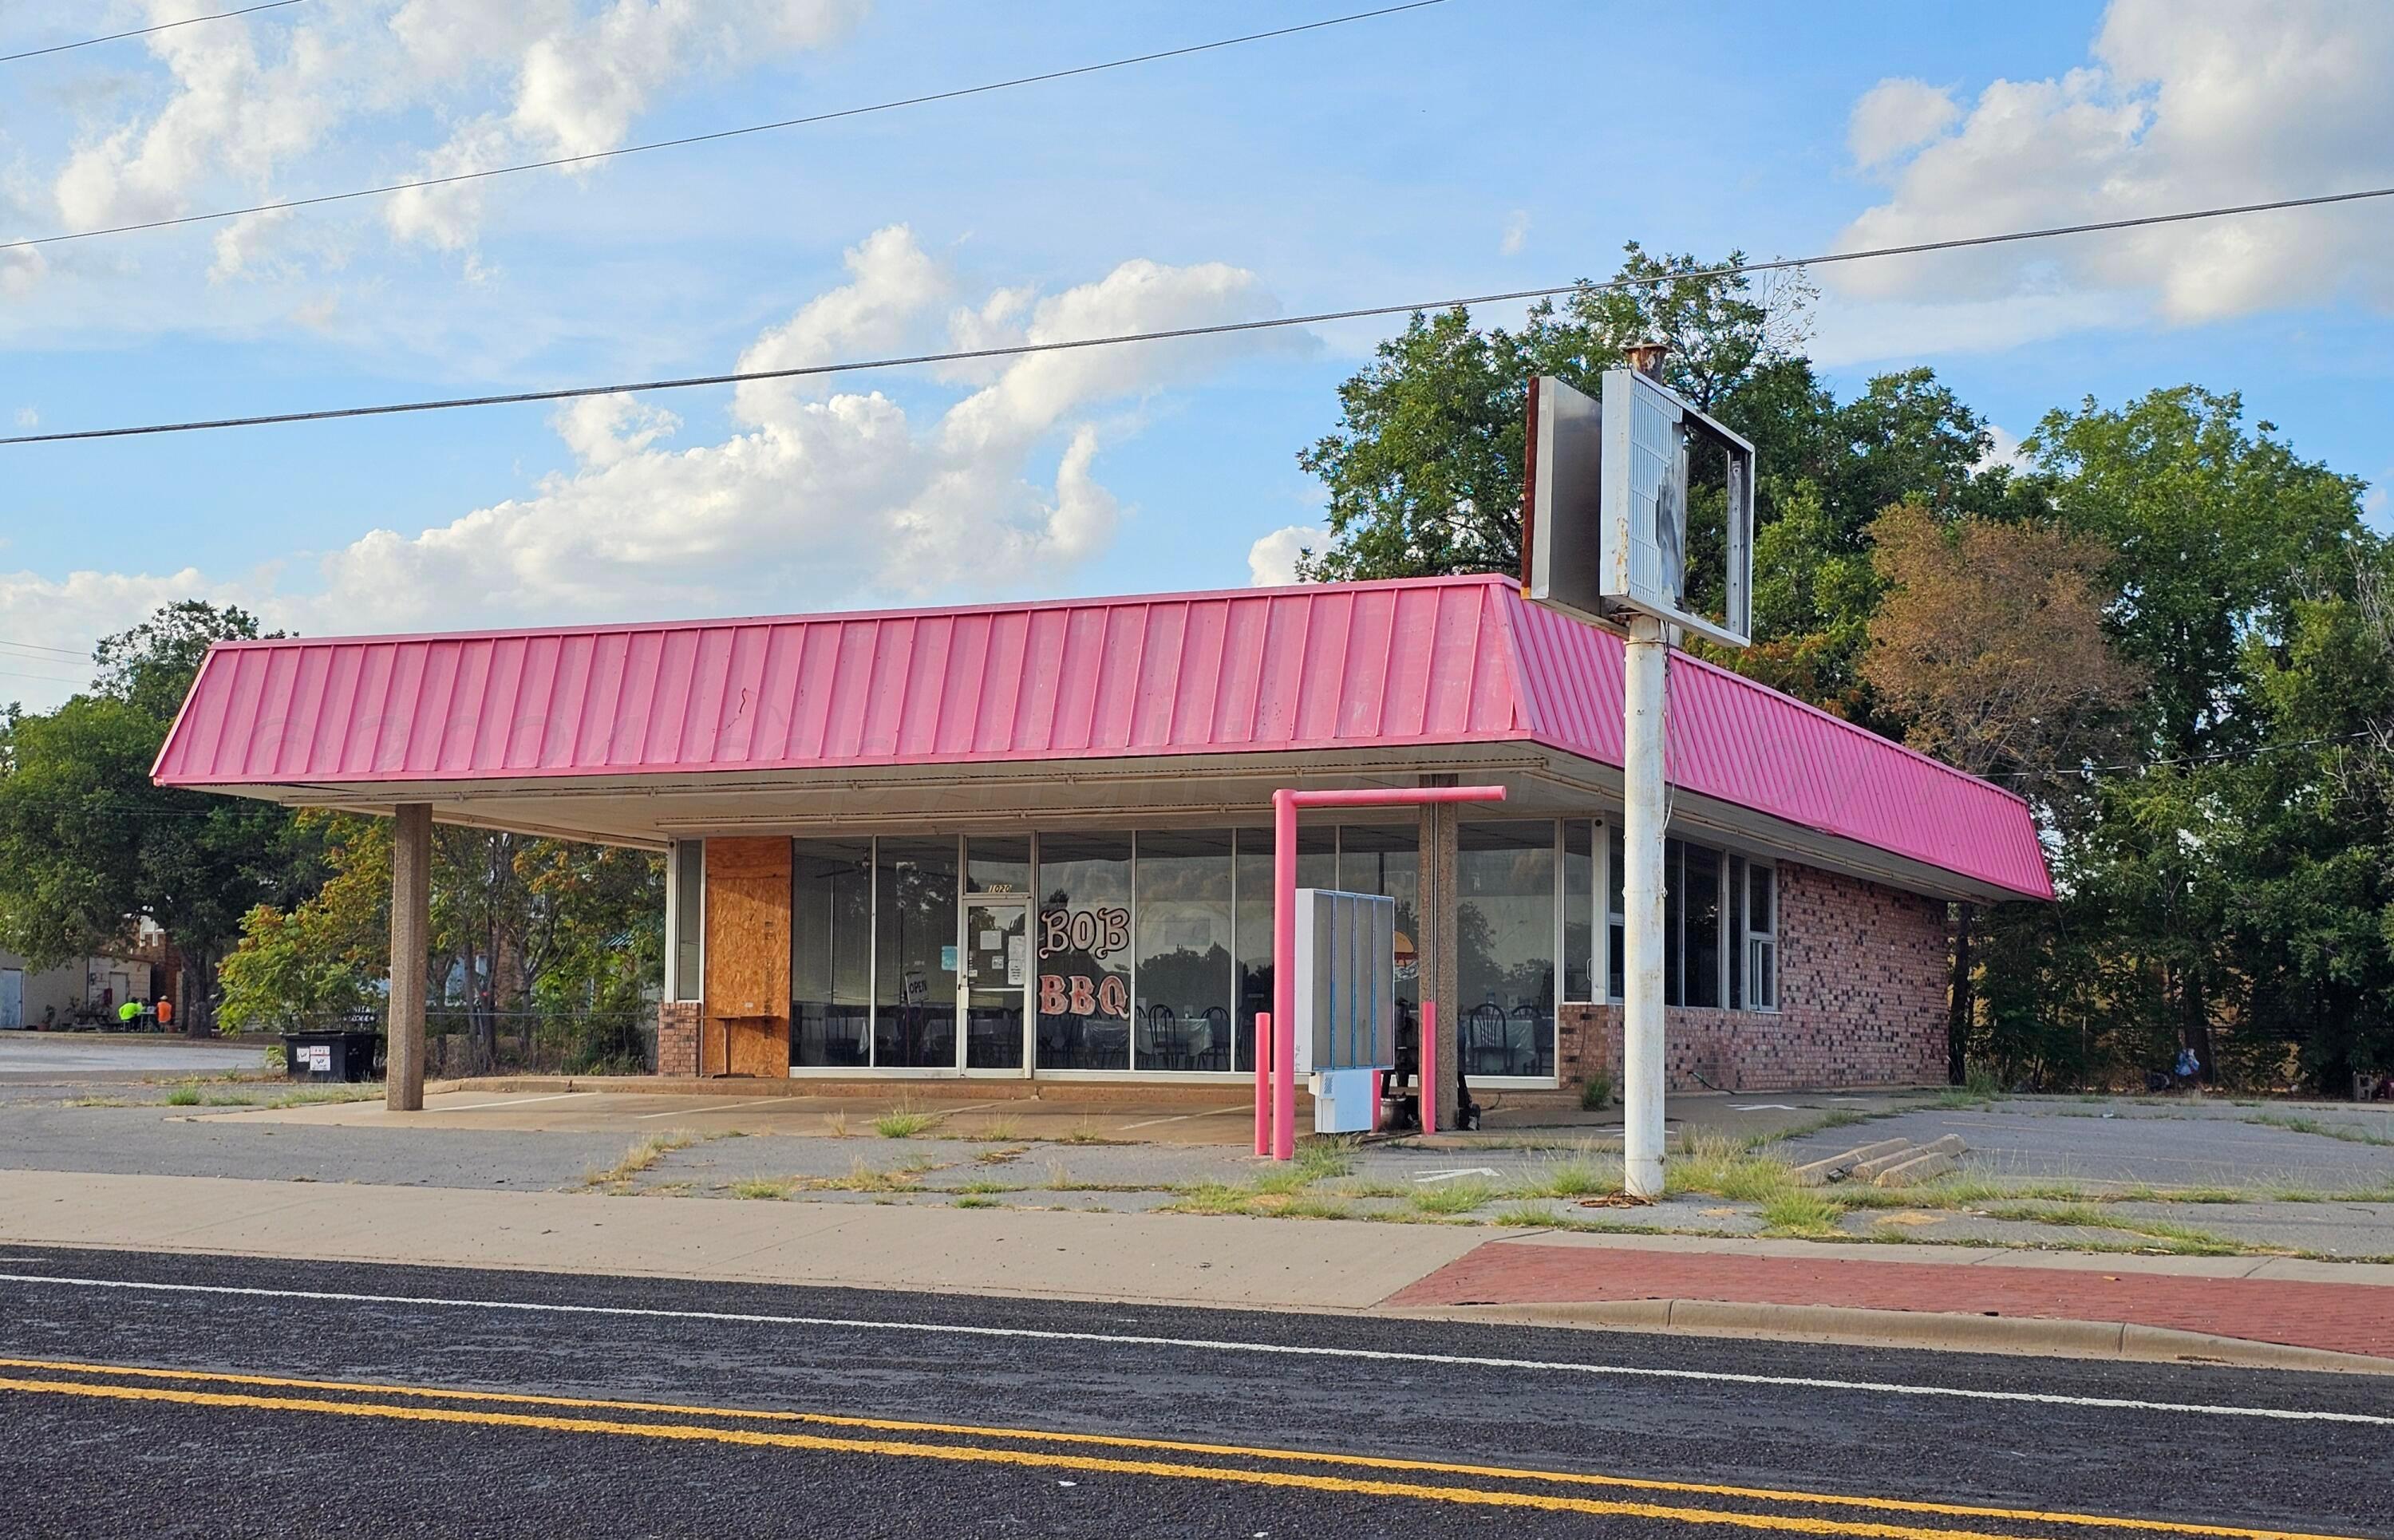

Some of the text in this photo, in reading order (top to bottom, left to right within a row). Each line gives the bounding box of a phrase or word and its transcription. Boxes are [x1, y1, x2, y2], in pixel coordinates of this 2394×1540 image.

[989, 884, 1012, 893] 1020
[1039, 907, 1130, 959] BOB
[909, 981, 927, 994] OPEN
[1039, 974, 1130, 1020] BBQ
